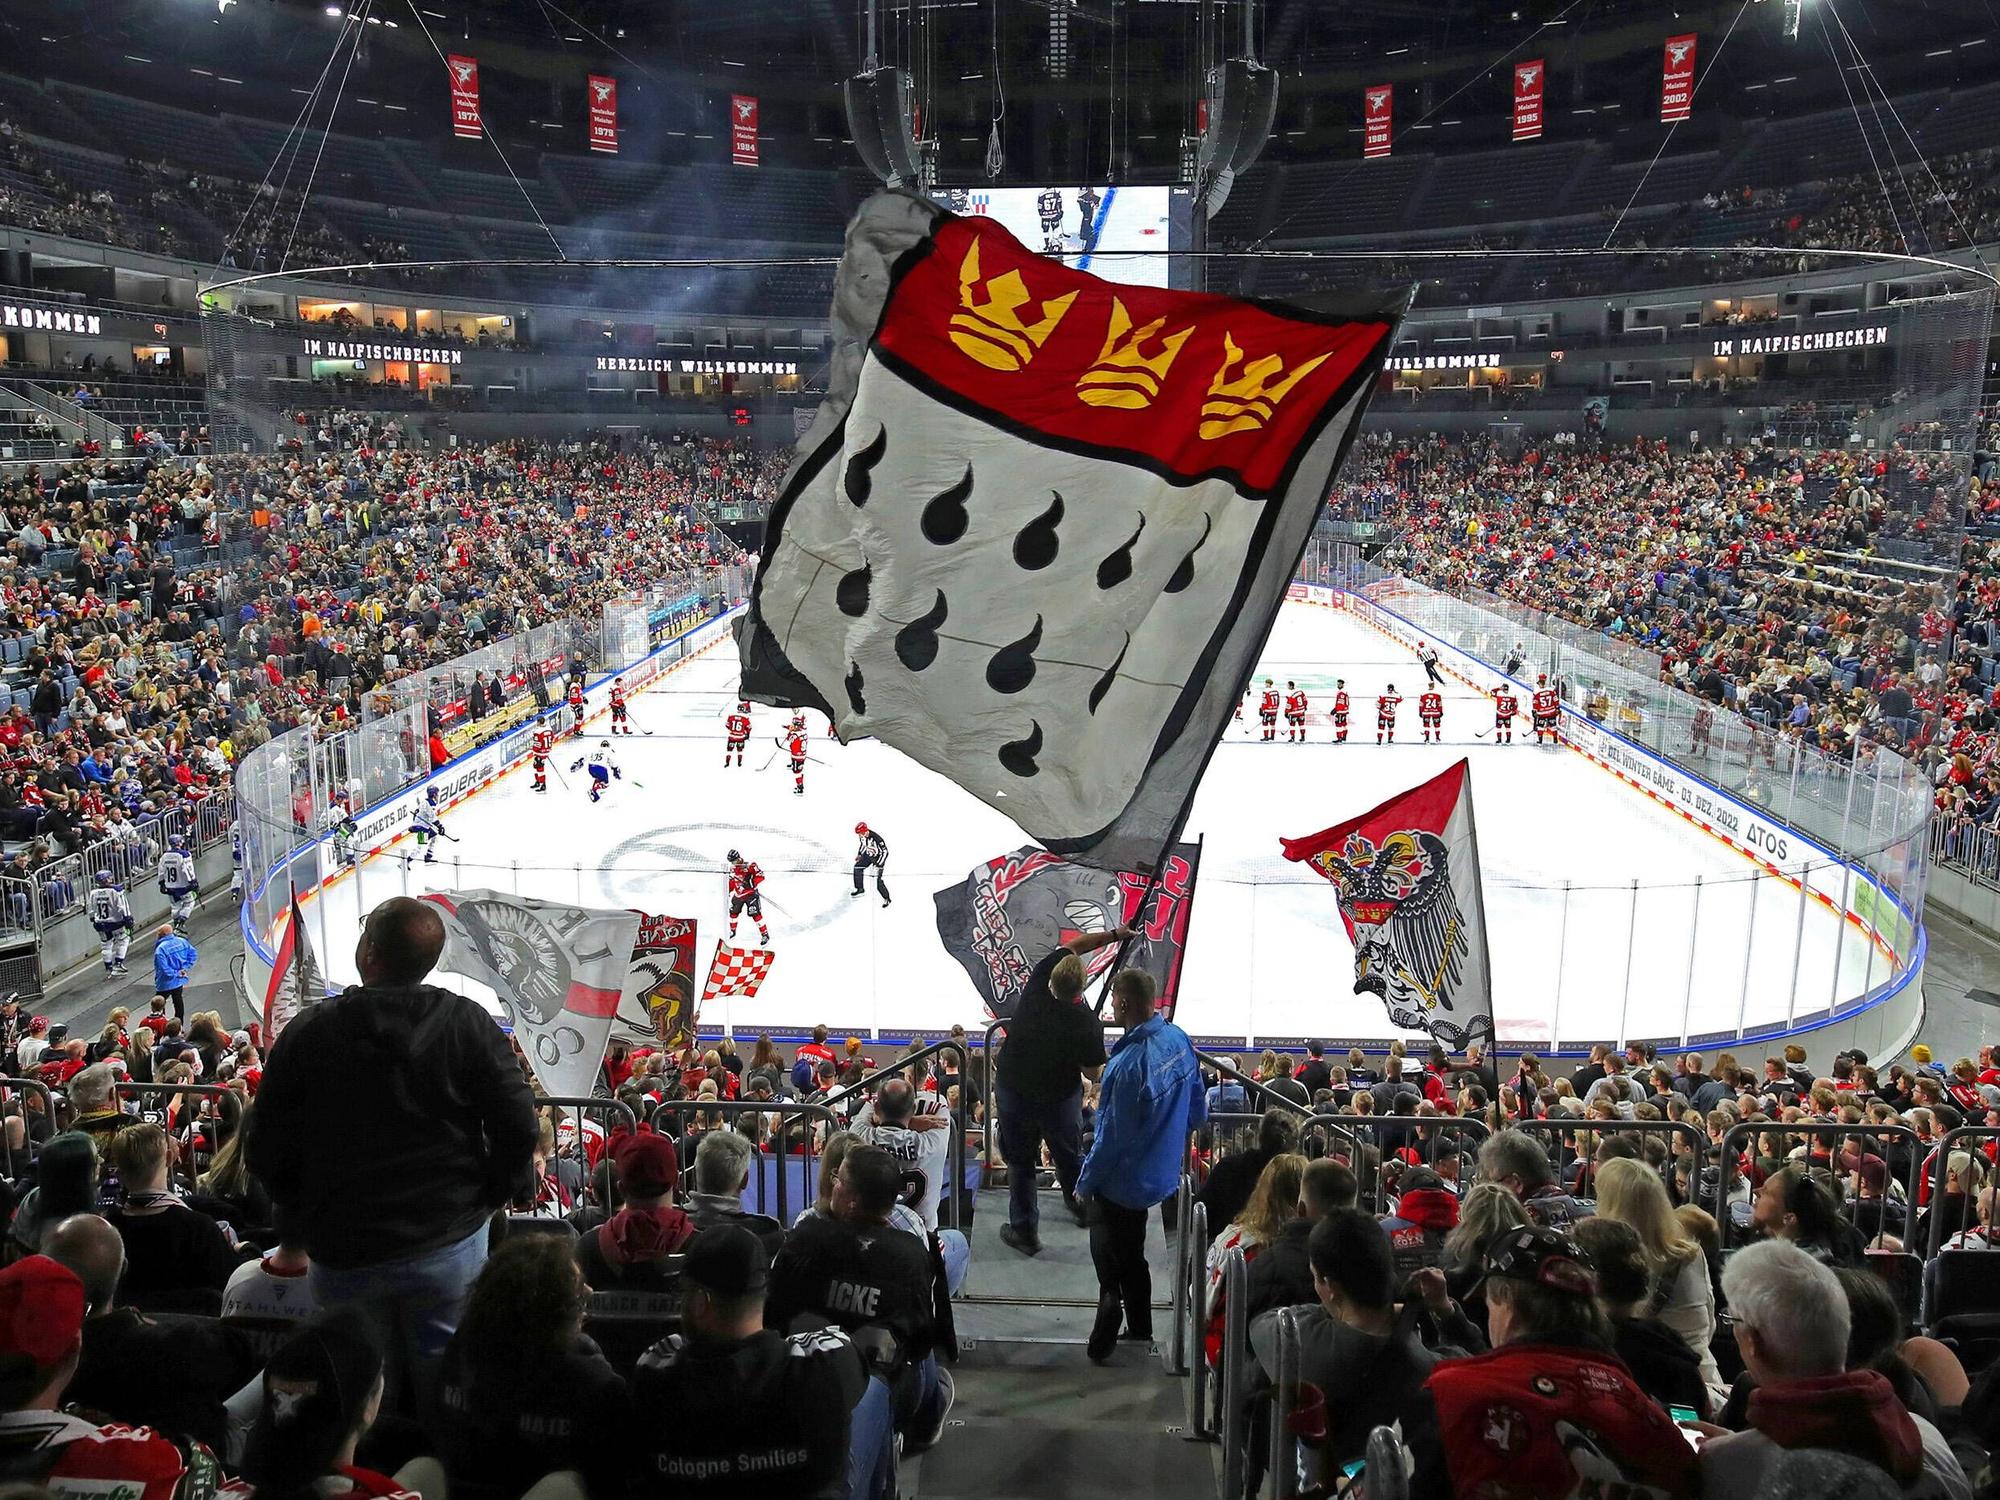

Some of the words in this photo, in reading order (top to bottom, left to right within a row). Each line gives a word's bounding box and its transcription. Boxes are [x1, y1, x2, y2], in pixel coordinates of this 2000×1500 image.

[1663, 93, 1687, 104] 2002
[457, 111, 478, 121] 1977
[1517, 113, 1538, 124] 1995
[1043, 200, 1056, 210] 67
[0, 305, 100, 335] KOMMEN
[1713, 340, 1733, 356] IM
[1741, 327, 1888, 354] HAIFISCHBECKEN
[304, 339, 321, 355] IM
[328, 341, 462, 364] HAIFISCHBECKEN
[597, 357, 673, 372] HERZLICH
[681, 359, 797, 375] WILLKOMMEN
[1426, 698, 1437, 709] 24
[1540, 696, 1552, 707] 57
[731, 721, 743, 732] 16
[1622, 753, 1651, 780] WINTER
[1652, 770, 1675, 794] GAME
[1716, 809, 1738, 832] 2022
[1746, 823, 1788, 860] ATOS
[166, 867, 177, 882] 19
[827, 1279, 882, 1318] ICKE
[657, 1453, 731, 1480] Cologne
[737, 1448, 808, 1472] Smilies
